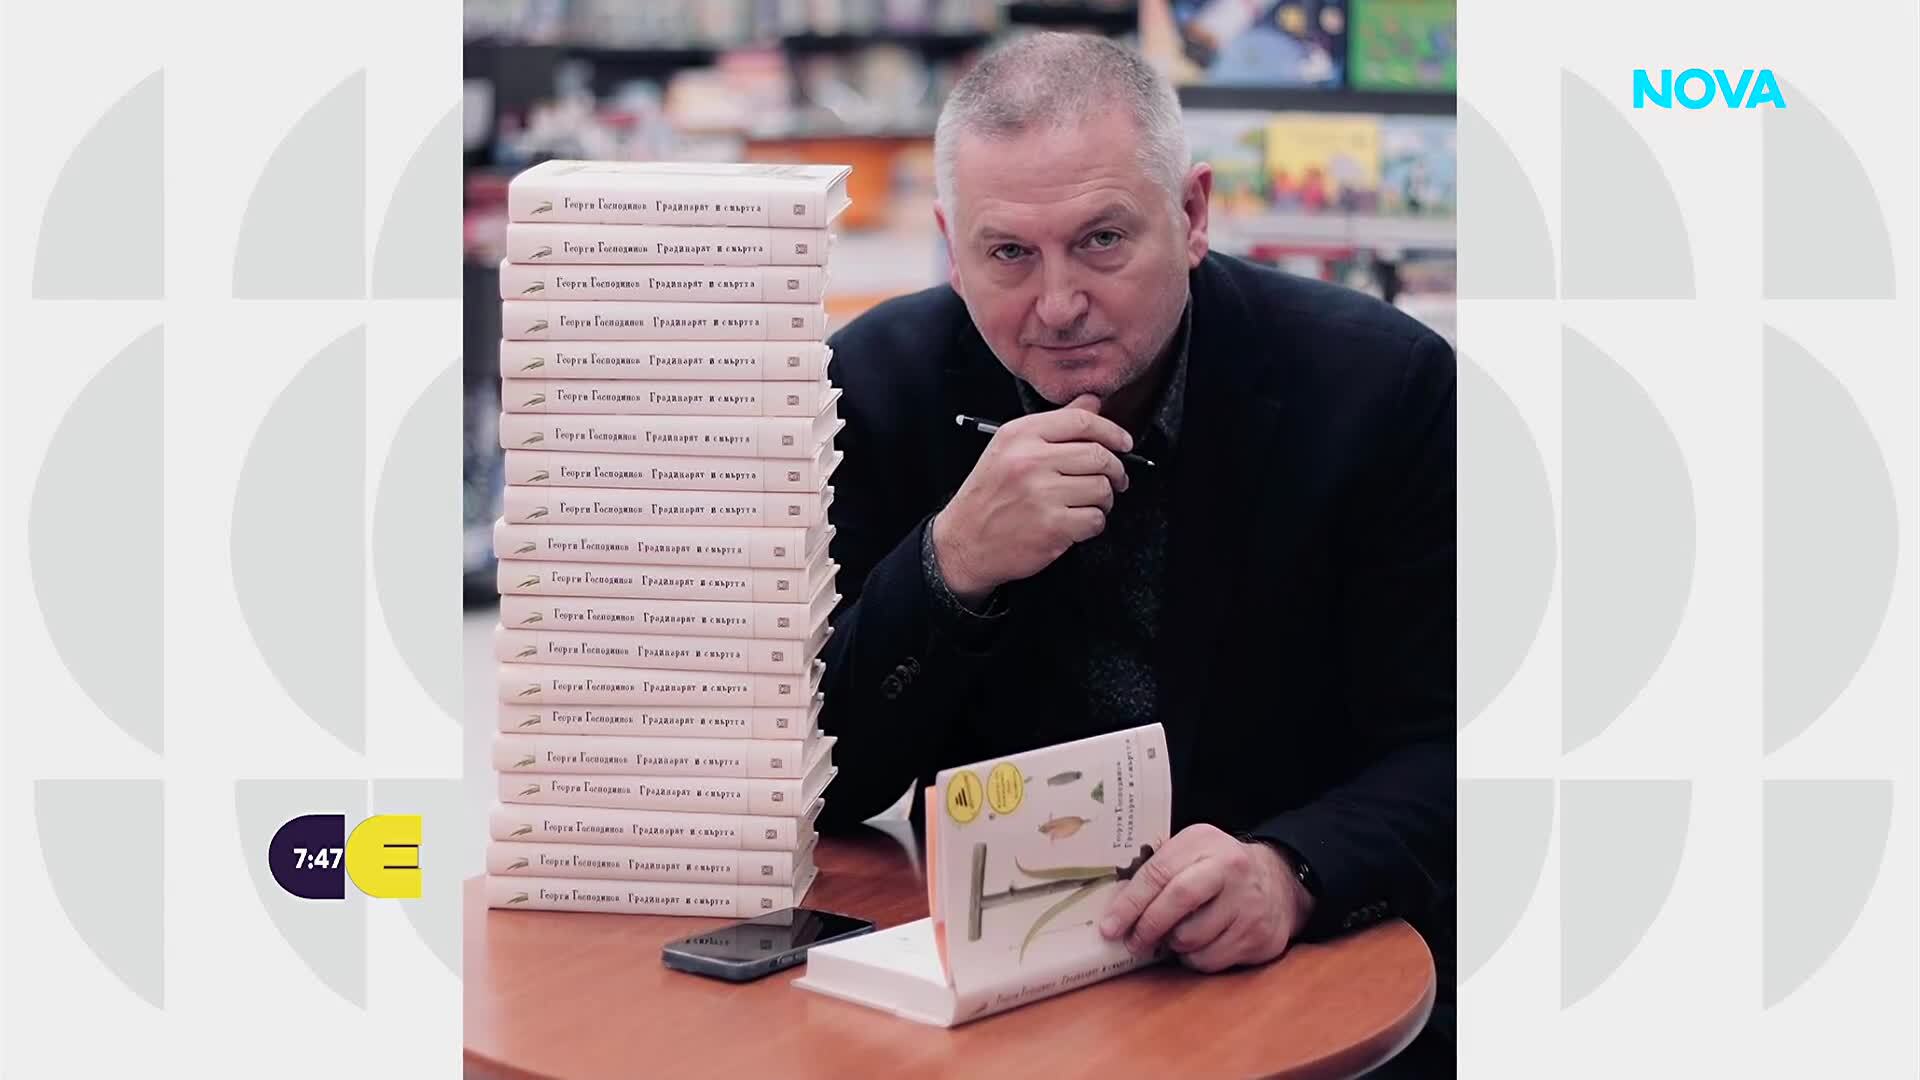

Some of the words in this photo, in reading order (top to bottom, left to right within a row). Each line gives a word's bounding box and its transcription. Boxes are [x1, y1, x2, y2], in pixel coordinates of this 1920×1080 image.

[564, 197, 596, 212] Георги
[598, 198, 648, 213] Господинов
[656, 199, 709, 214] Градинарят
[564, 242, 596, 255] Георги
[597, 241, 648, 255] Господинов
[656, 241, 711, 255] Градинарят
[556, 276, 588, 290] Георги
[589, 276, 640, 290] Господинов
[648, 276, 702, 290] Градинарят
[560, 316, 592, 329] Георги
[593, 315, 644, 329] Господинов
[652, 315, 707, 329] Градинарят
[556, 352, 588, 367] Георги
[590, 353, 641, 367] Господинов
[649, 353, 703, 367] Градинарят
[557, 389, 589, 403] Георги
[591, 389, 641, 404] Господинов
[649, 390, 703, 405] Градинарят
[554, 428, 586, 442] Георги
[588, 428, 637, 443] Господинов
[645, 429, 698, 445] Градинарят
[560, 466, 591, 481] Георги
[593, 467, 643, 481] Господинов
[651, 467, 704, 481] Градинарят
[560, 502, 591, 516] Георги
[593, 502, 643, 516] Господинов
[651, 502, 705, 516] Градинарят
[547, 538, 578, 552] Георги
[580, 538, 630, 553] Господинов
[638, 539, 691, 555] Градинарят
[552, 571, 583, 586] Георги
[584, 572, 634, 587] Господинов
[642, 573, 695, 588] Градинарят
[554, 608, 585, 622] Георги
[586, 608, 636, 624] Господинов
[643, 610, 696, 626] Градинарят
[548, 641, 579, 656] Георги
[581, 642, 630, 657] Господинов
[638, 643, 690, 659] Градинарят
[552, 680, 584, 694] Георги
[586, 680, 635, 694] Господинов
[643, 680, 696, 694] Градинарят
[552, 712, 583, 726] Георги
[585, 712, 634, 727] Господинов
[642, 713, 694, 727] Градинарят
[546, 752, 578, 766] Георги
[579, 752, 628, 766] Господинов
[636, 753, 688, 767] Градинарят
[551, 780, 582, 795] Георги
[583, 781, 632, 797] Господинов
[639, 783, 691, 799] Градинарят
[544, 820, 574, 835] Георги
[576, 821, 625, 836] Господинов
[632, 822, 684, 837] Градинарят
[540, 854, 570, 869] Георги
[572, 855, 621, 870] Господинов
[628, 857, 680, 872] Градинарят
[540, 888, 570, 903] Георги
[572, 889, 620, 904] Господинов
[628, 891, 680, 906] Градинарят
